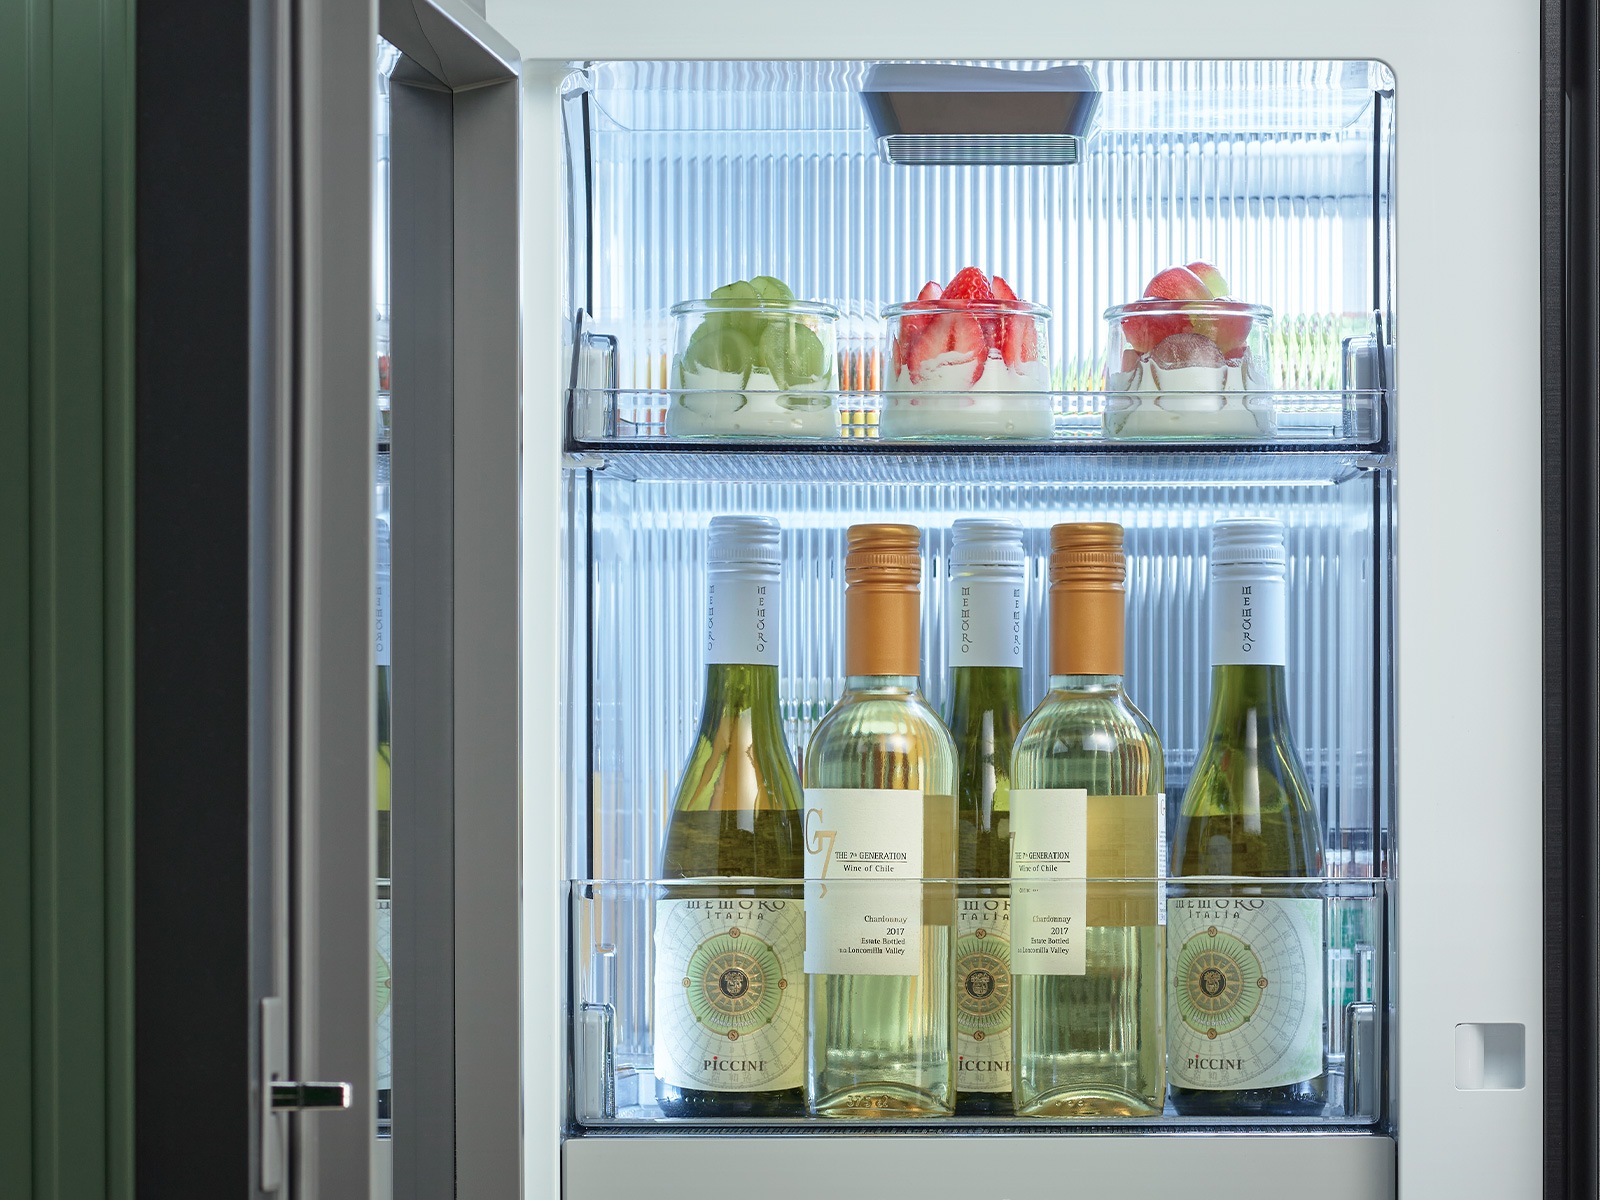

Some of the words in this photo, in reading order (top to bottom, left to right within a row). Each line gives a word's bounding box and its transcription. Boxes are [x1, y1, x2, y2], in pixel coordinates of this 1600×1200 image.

[835, 851, 848, 860] THE
[860, 851, 907, 860] GENERATION
[1029, 851, 1070, 860] GENERATION
[843, 864, 861, 872] Wine
[864, 864, 873, 872] of
[875, 864, 894, 873] Chile
[1032, 864, 1040, 872] of
[1041, 864, 1058, 872] Chile
[707, 910, 764, 920] ITALIA
[961, 911, 1009, 921] TALIA
[1189, 909, 1240, 919] ITALIA
[864, 914, 908, 925] Chardonnay
[1032, 914, 1071, 925] Chardonnay
[886, 927, 905, 936] 2017
[1051, 926, 1069, 935] 2017
[861, 937, 881, 945] Estate
[882, 937, 906, 945] Bottled
[848, 946, 883, 954] Loncomilla
[885, 947, 906, 956] Valley
[1050, 946, 1070, 956] Valley
